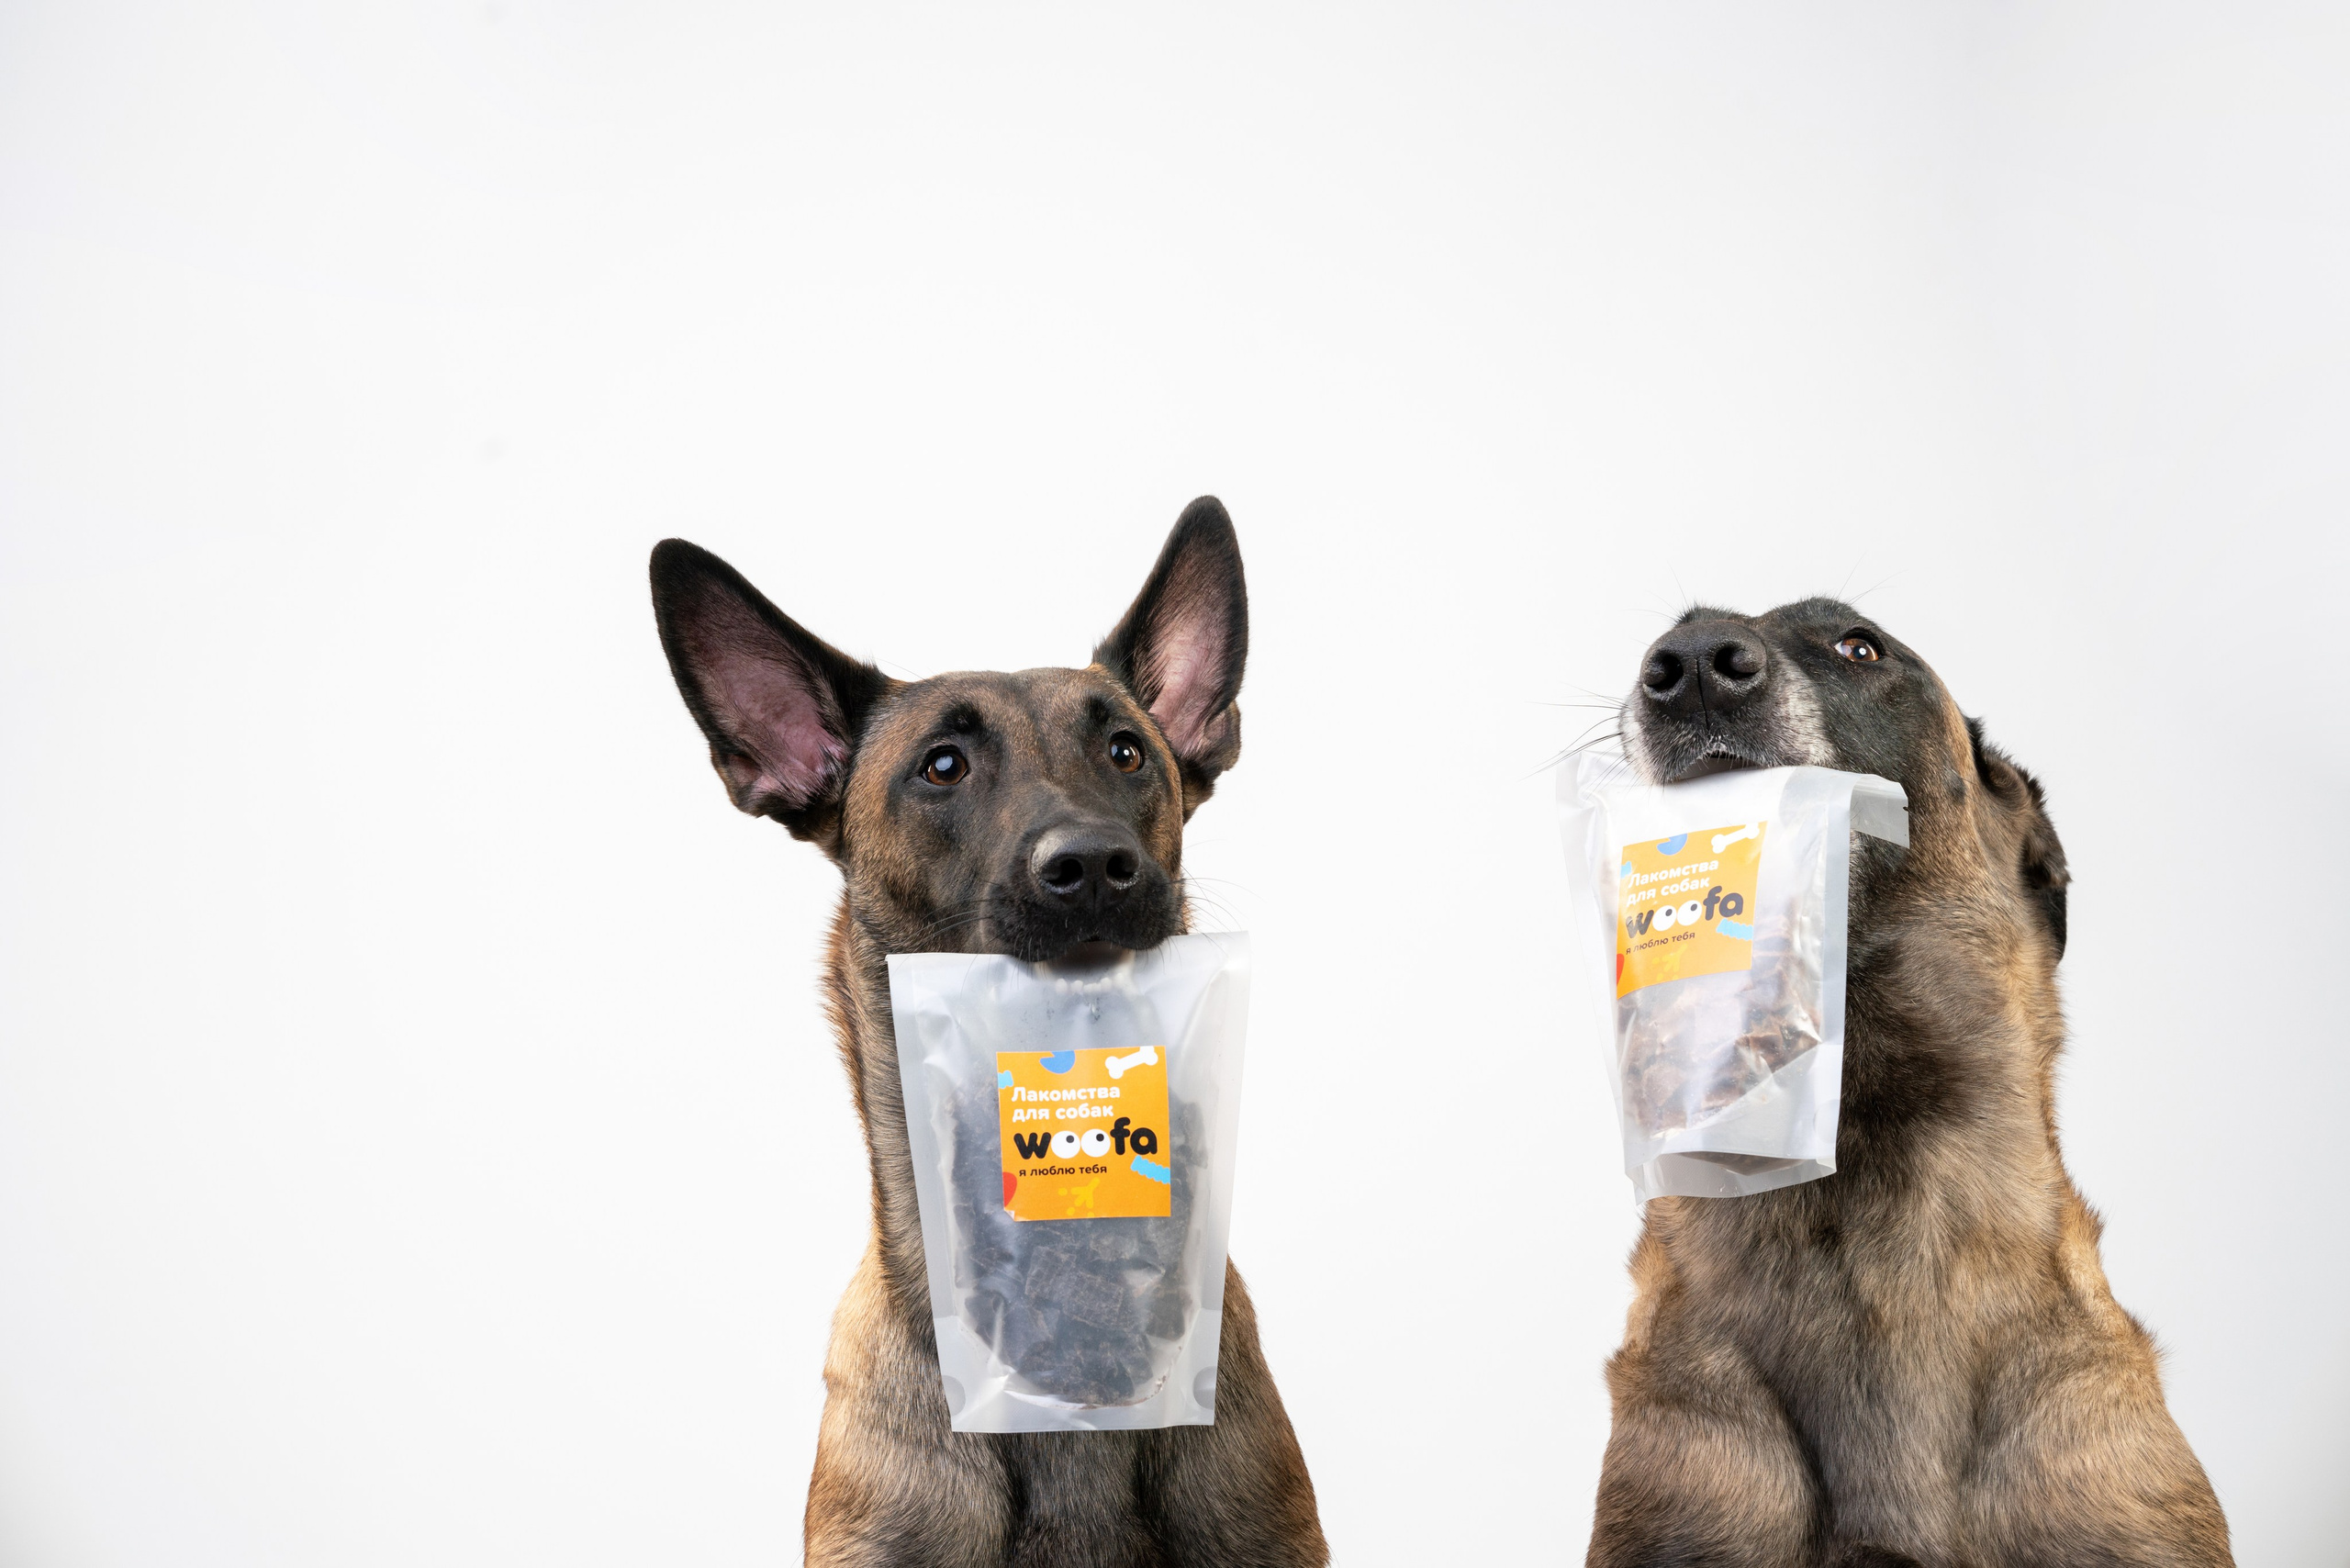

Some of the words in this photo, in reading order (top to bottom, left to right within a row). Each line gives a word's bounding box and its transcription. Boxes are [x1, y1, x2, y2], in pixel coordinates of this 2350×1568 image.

[1628, 859, 1719, 889] Лакомства
[1626, 888, 1656, 908] для
[1661, 877, 1710, 897] собак
[1626, 885, 1744, 939] woofa
[1626, 946, 1631, 956] я
[1633, 937, 1669, 953] люблю
[1672, 932, 1695, 944] тебя
[1011, 1086, 1121, 1103] Лакомства
[1012, 1107, 1050, 1123] для
[1055, 1103, 1114, 1120] собак
[1013, 1116, 1158, 1159] woofa
[1019, 1169, 1026, 1177] я
[1030, 1165, 1076, 1176] люблю
[1079, 1164, 1107, 1174] тебя
